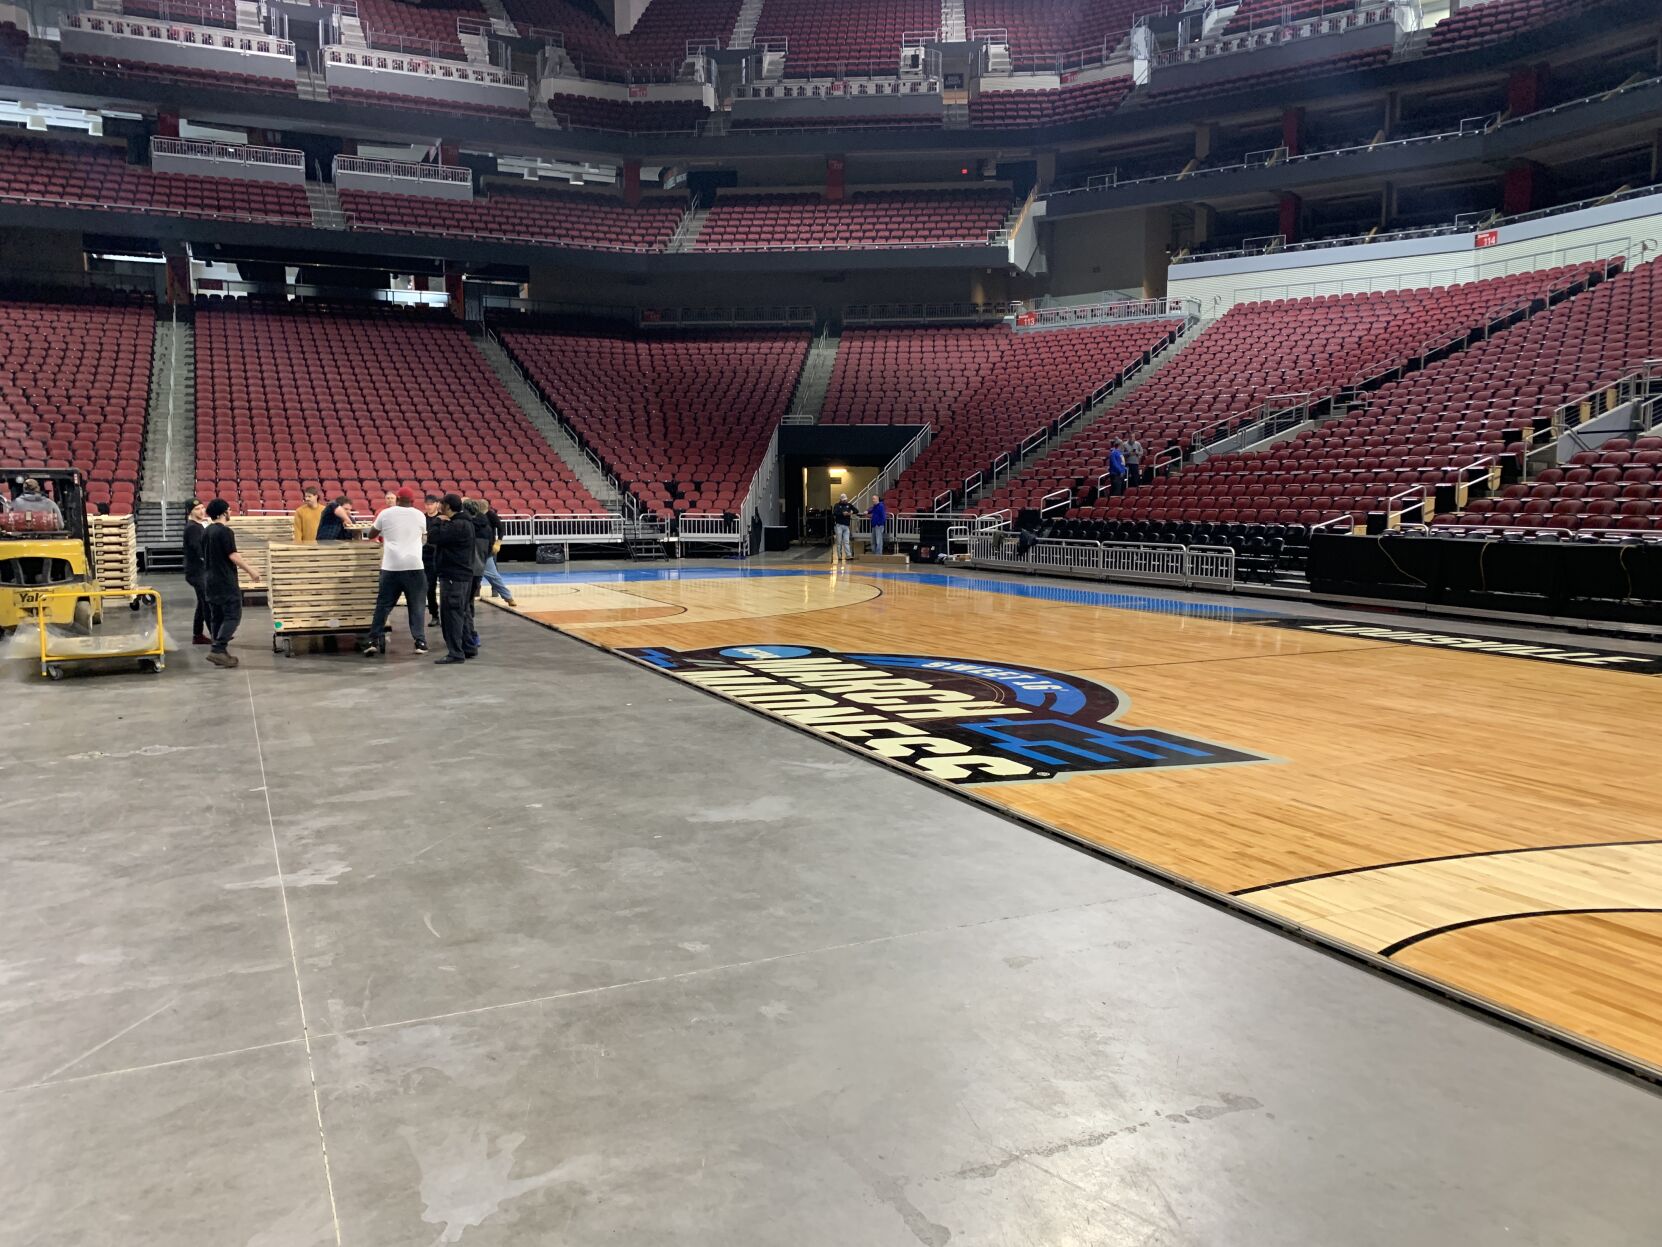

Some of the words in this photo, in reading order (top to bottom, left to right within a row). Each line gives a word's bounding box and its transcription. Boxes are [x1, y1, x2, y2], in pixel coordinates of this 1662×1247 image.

[1301, 624, 1654, 664] LOUISVILLE
[734, 657, 1033, 719] MARCH
[921, 661, 1036, 680] SWEET
[1012, 680, 1064, 691] 16
